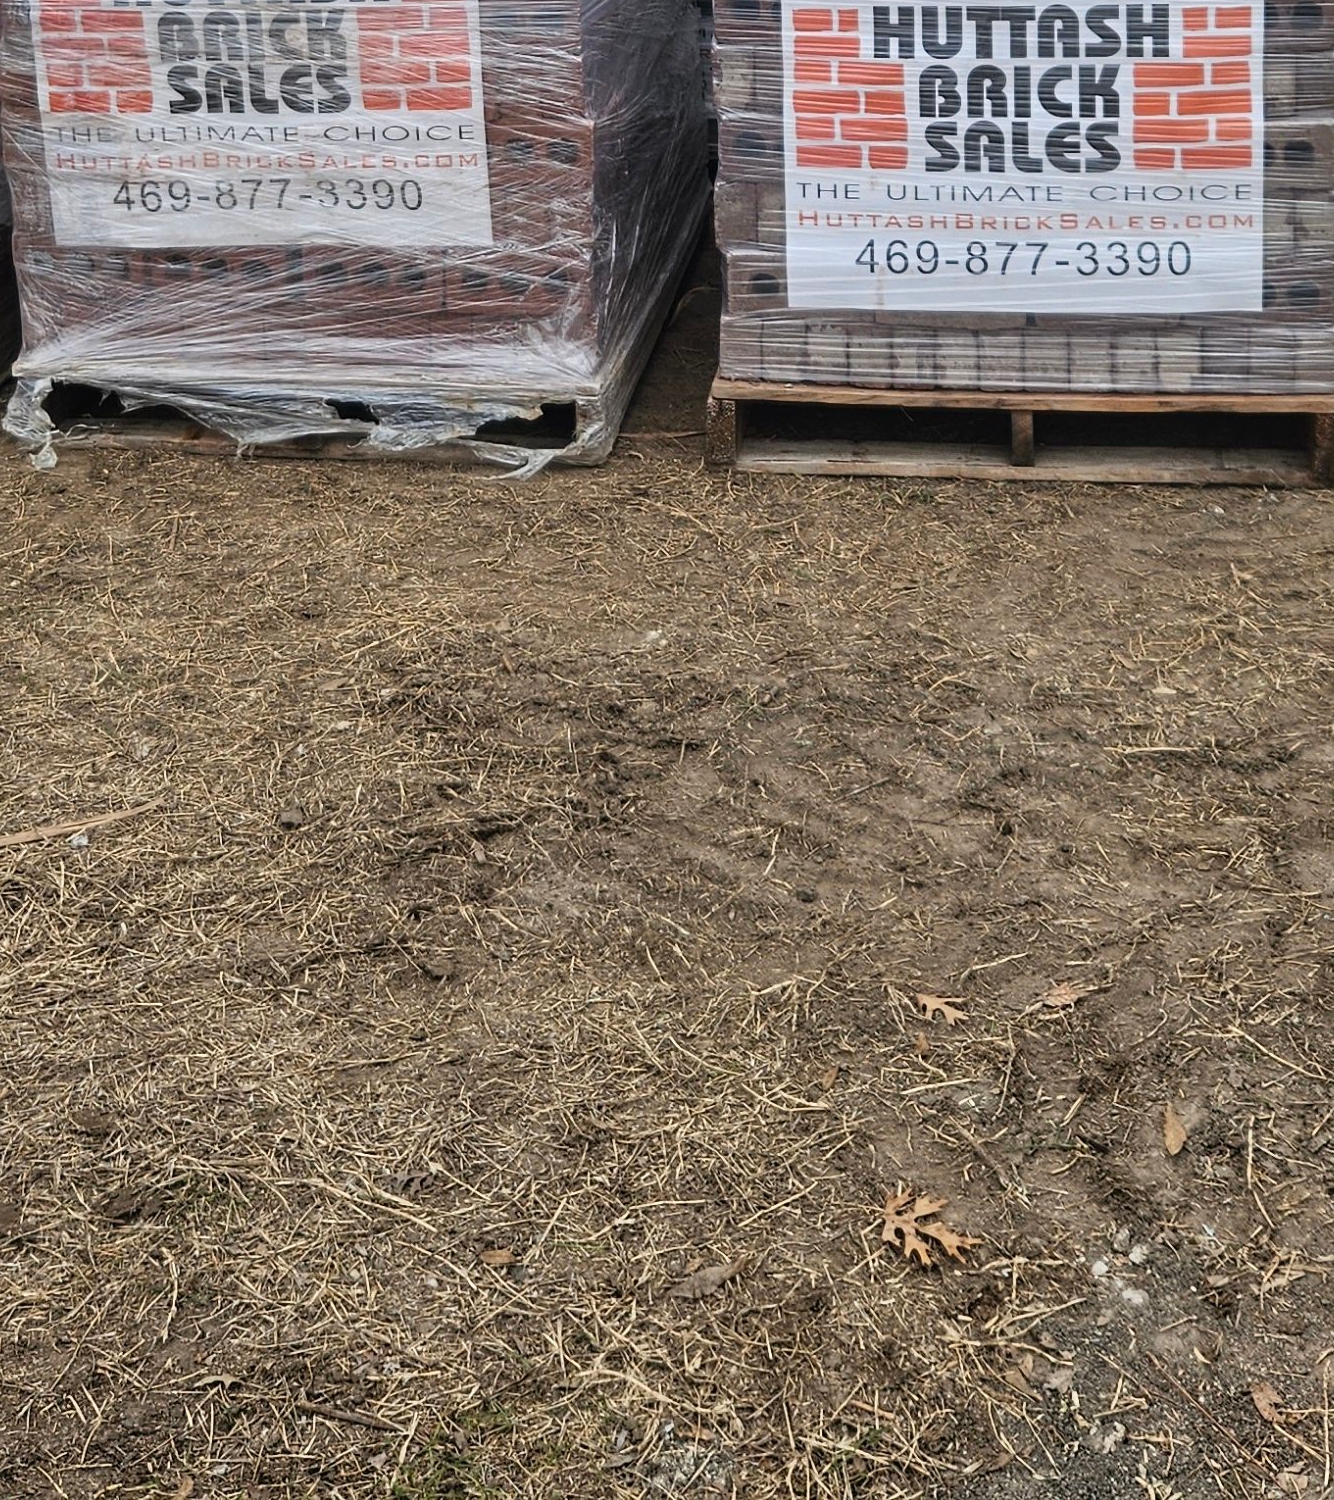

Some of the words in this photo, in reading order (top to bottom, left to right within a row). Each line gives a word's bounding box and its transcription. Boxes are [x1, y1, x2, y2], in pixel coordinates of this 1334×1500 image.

[157, 8, 346, 63] BRICK
[873, 4, 1170, 59] HUTTASH
[169, 63, 351, 115] SALES
[919, 64, 1121, 118] BRICK
[55, 127, 112, 142] THE
[136, 126, 298, 142] ULTIMATE
[323, 125, 473, 140] CHOICE
[925, 121, 1121, 173] SALES
[113, 179, 423, 212] 469-877-3390
[796, 182, 860, 200] THE
[887, 184, 1063, 202] ULTIMATE
[1090, 183, 1252, 201] CHOICE
[798, 211, 1253, 230] HUTTASHBRICKSALES.COM
[855, 239, 1192, 276] 469-877-3390
